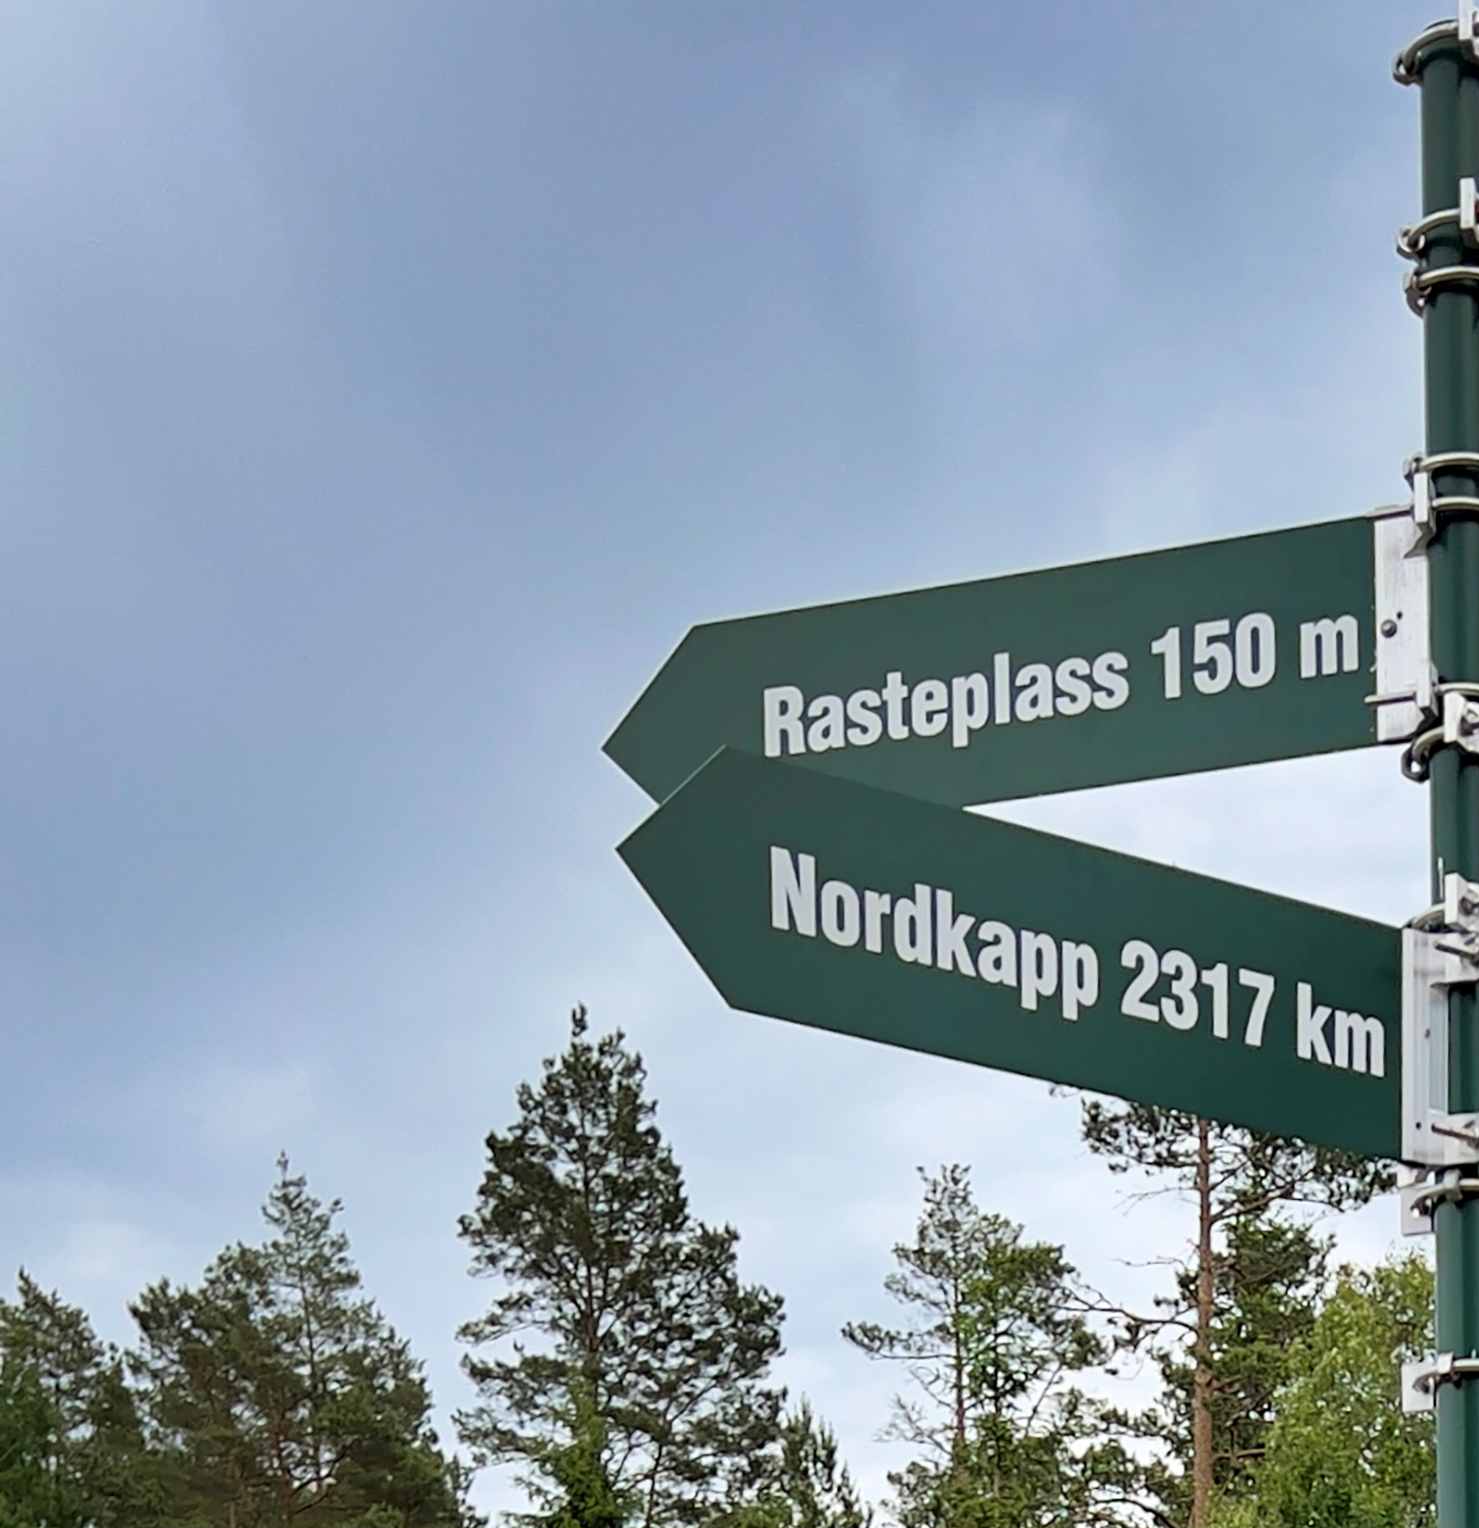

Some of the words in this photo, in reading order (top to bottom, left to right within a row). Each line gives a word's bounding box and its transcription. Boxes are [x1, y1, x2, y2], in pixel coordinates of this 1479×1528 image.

[763, 652, 1130, 758] Rasteplass
[1151, 612, 1277, 699] 150
[1299, 614, 1359, 679] m
[770, 845, 1099, 1021] Nordkapp
[1120, 940, 1275, 1047] 2317
[1297, 981, 1385, 1078] km
